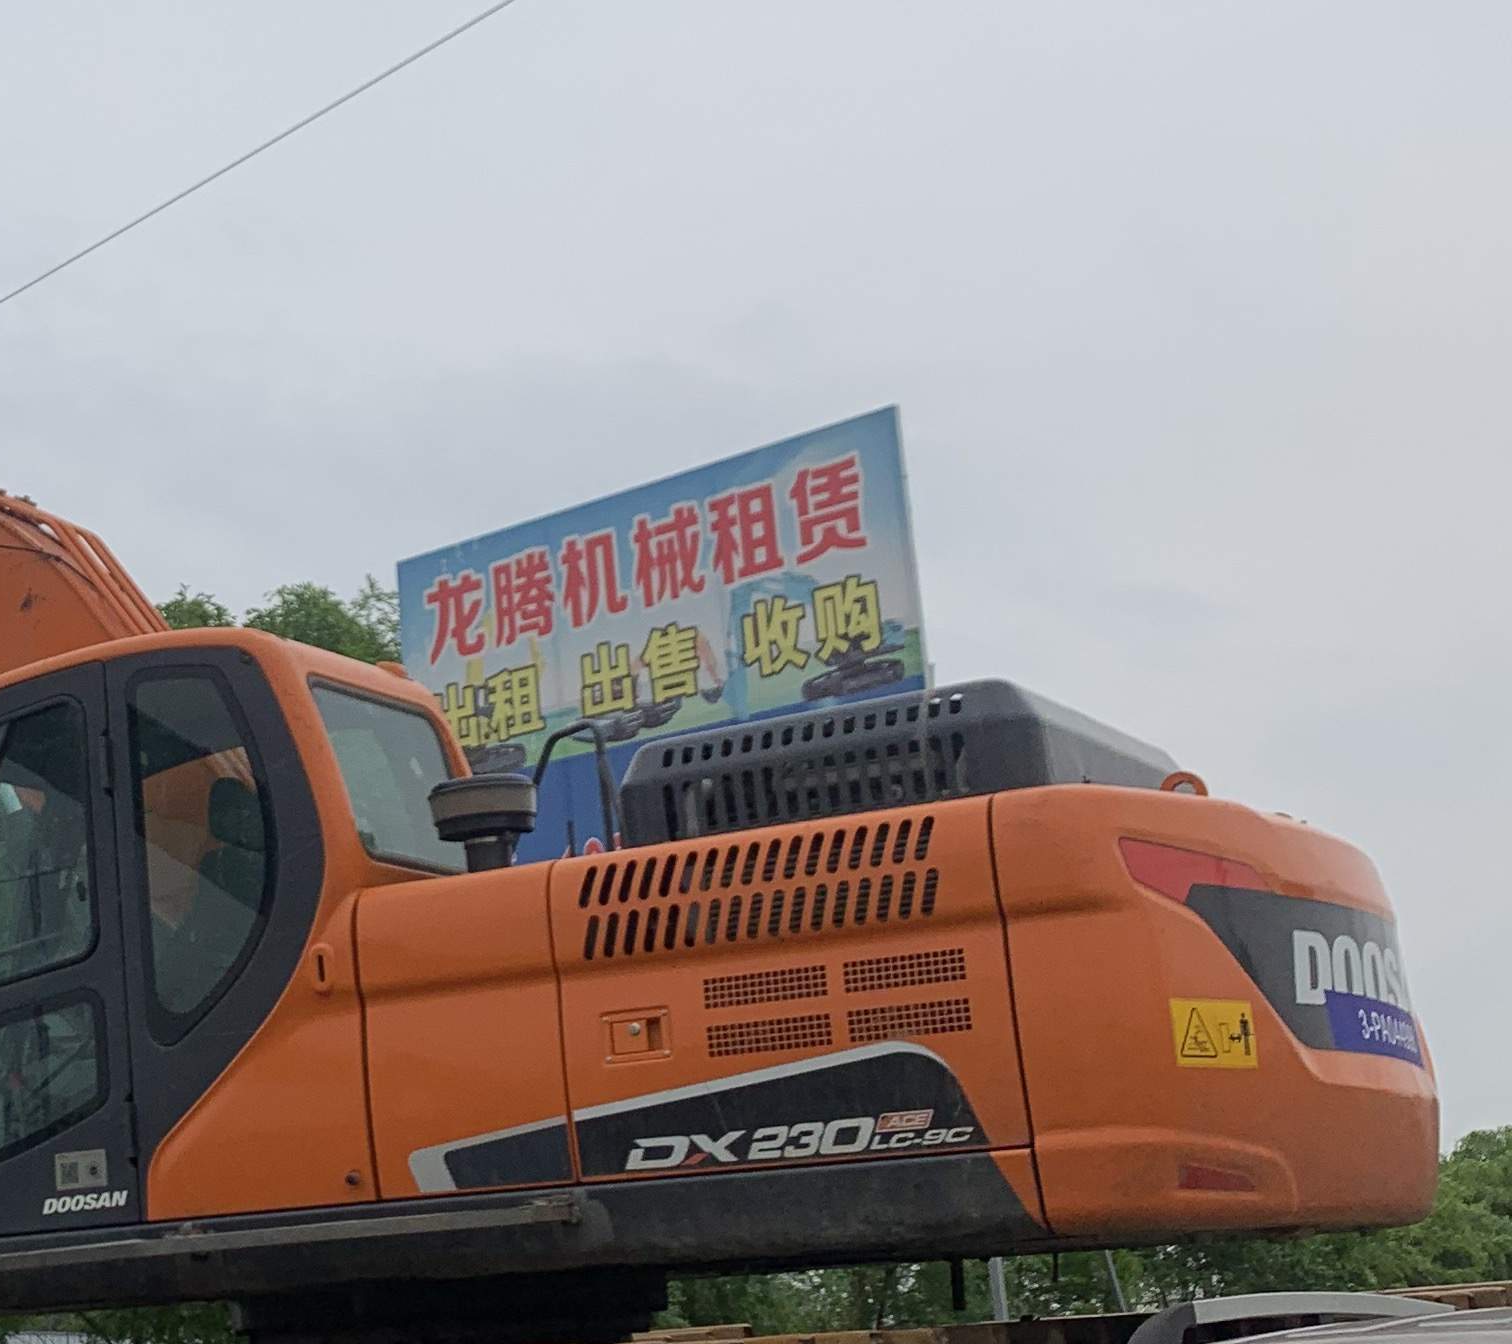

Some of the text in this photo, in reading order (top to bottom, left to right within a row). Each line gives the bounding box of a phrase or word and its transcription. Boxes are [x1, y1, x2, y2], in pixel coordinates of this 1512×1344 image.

[425, 455, 868, 664] 龙腾机械租赁
[435, 575, 882, 748] 出租 出售 收购
[42, 1190, 129, 1215] DOOSAN
